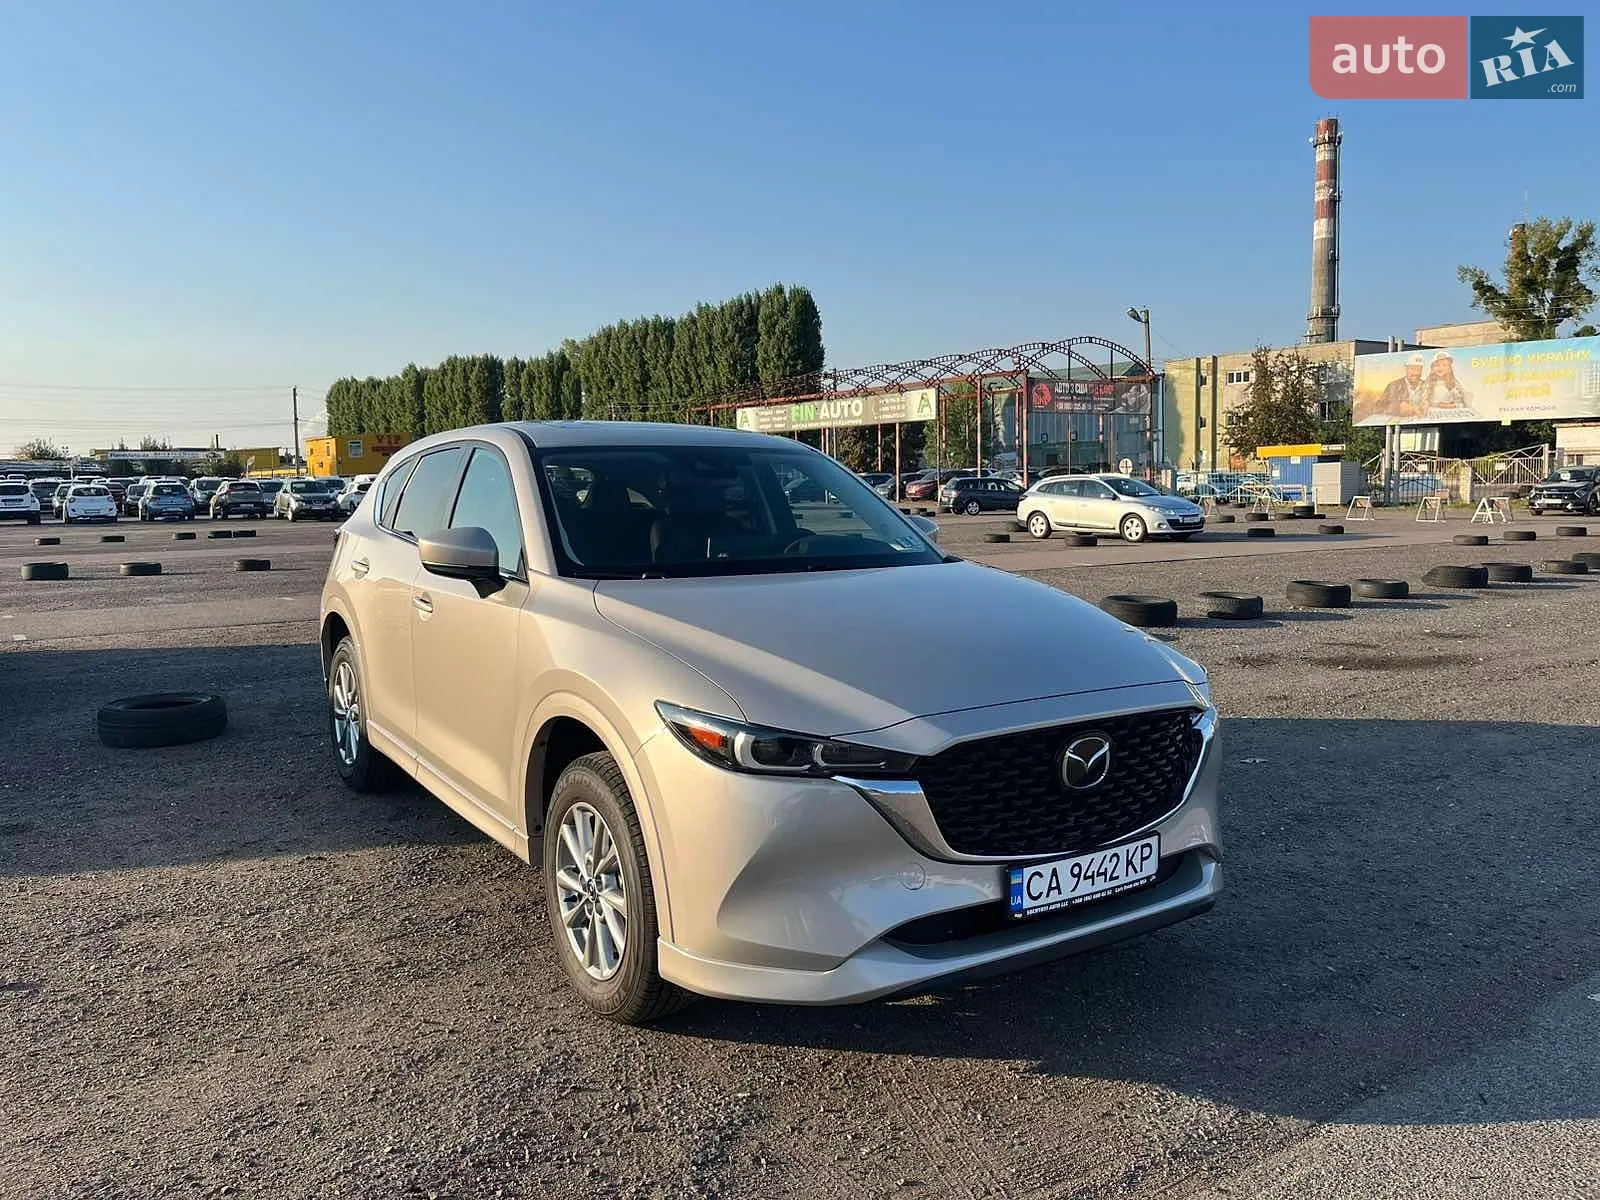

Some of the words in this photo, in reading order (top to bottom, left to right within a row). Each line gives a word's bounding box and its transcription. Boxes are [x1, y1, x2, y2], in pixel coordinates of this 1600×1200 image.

[819, 401, 864, 420] AUTO
[1026, 867, 1062, 901] CA
[1069, 853, 1120, 893] 9442
[1125, 842, 1153, 877] KP
[1011, 895, 1022, 906] UA
